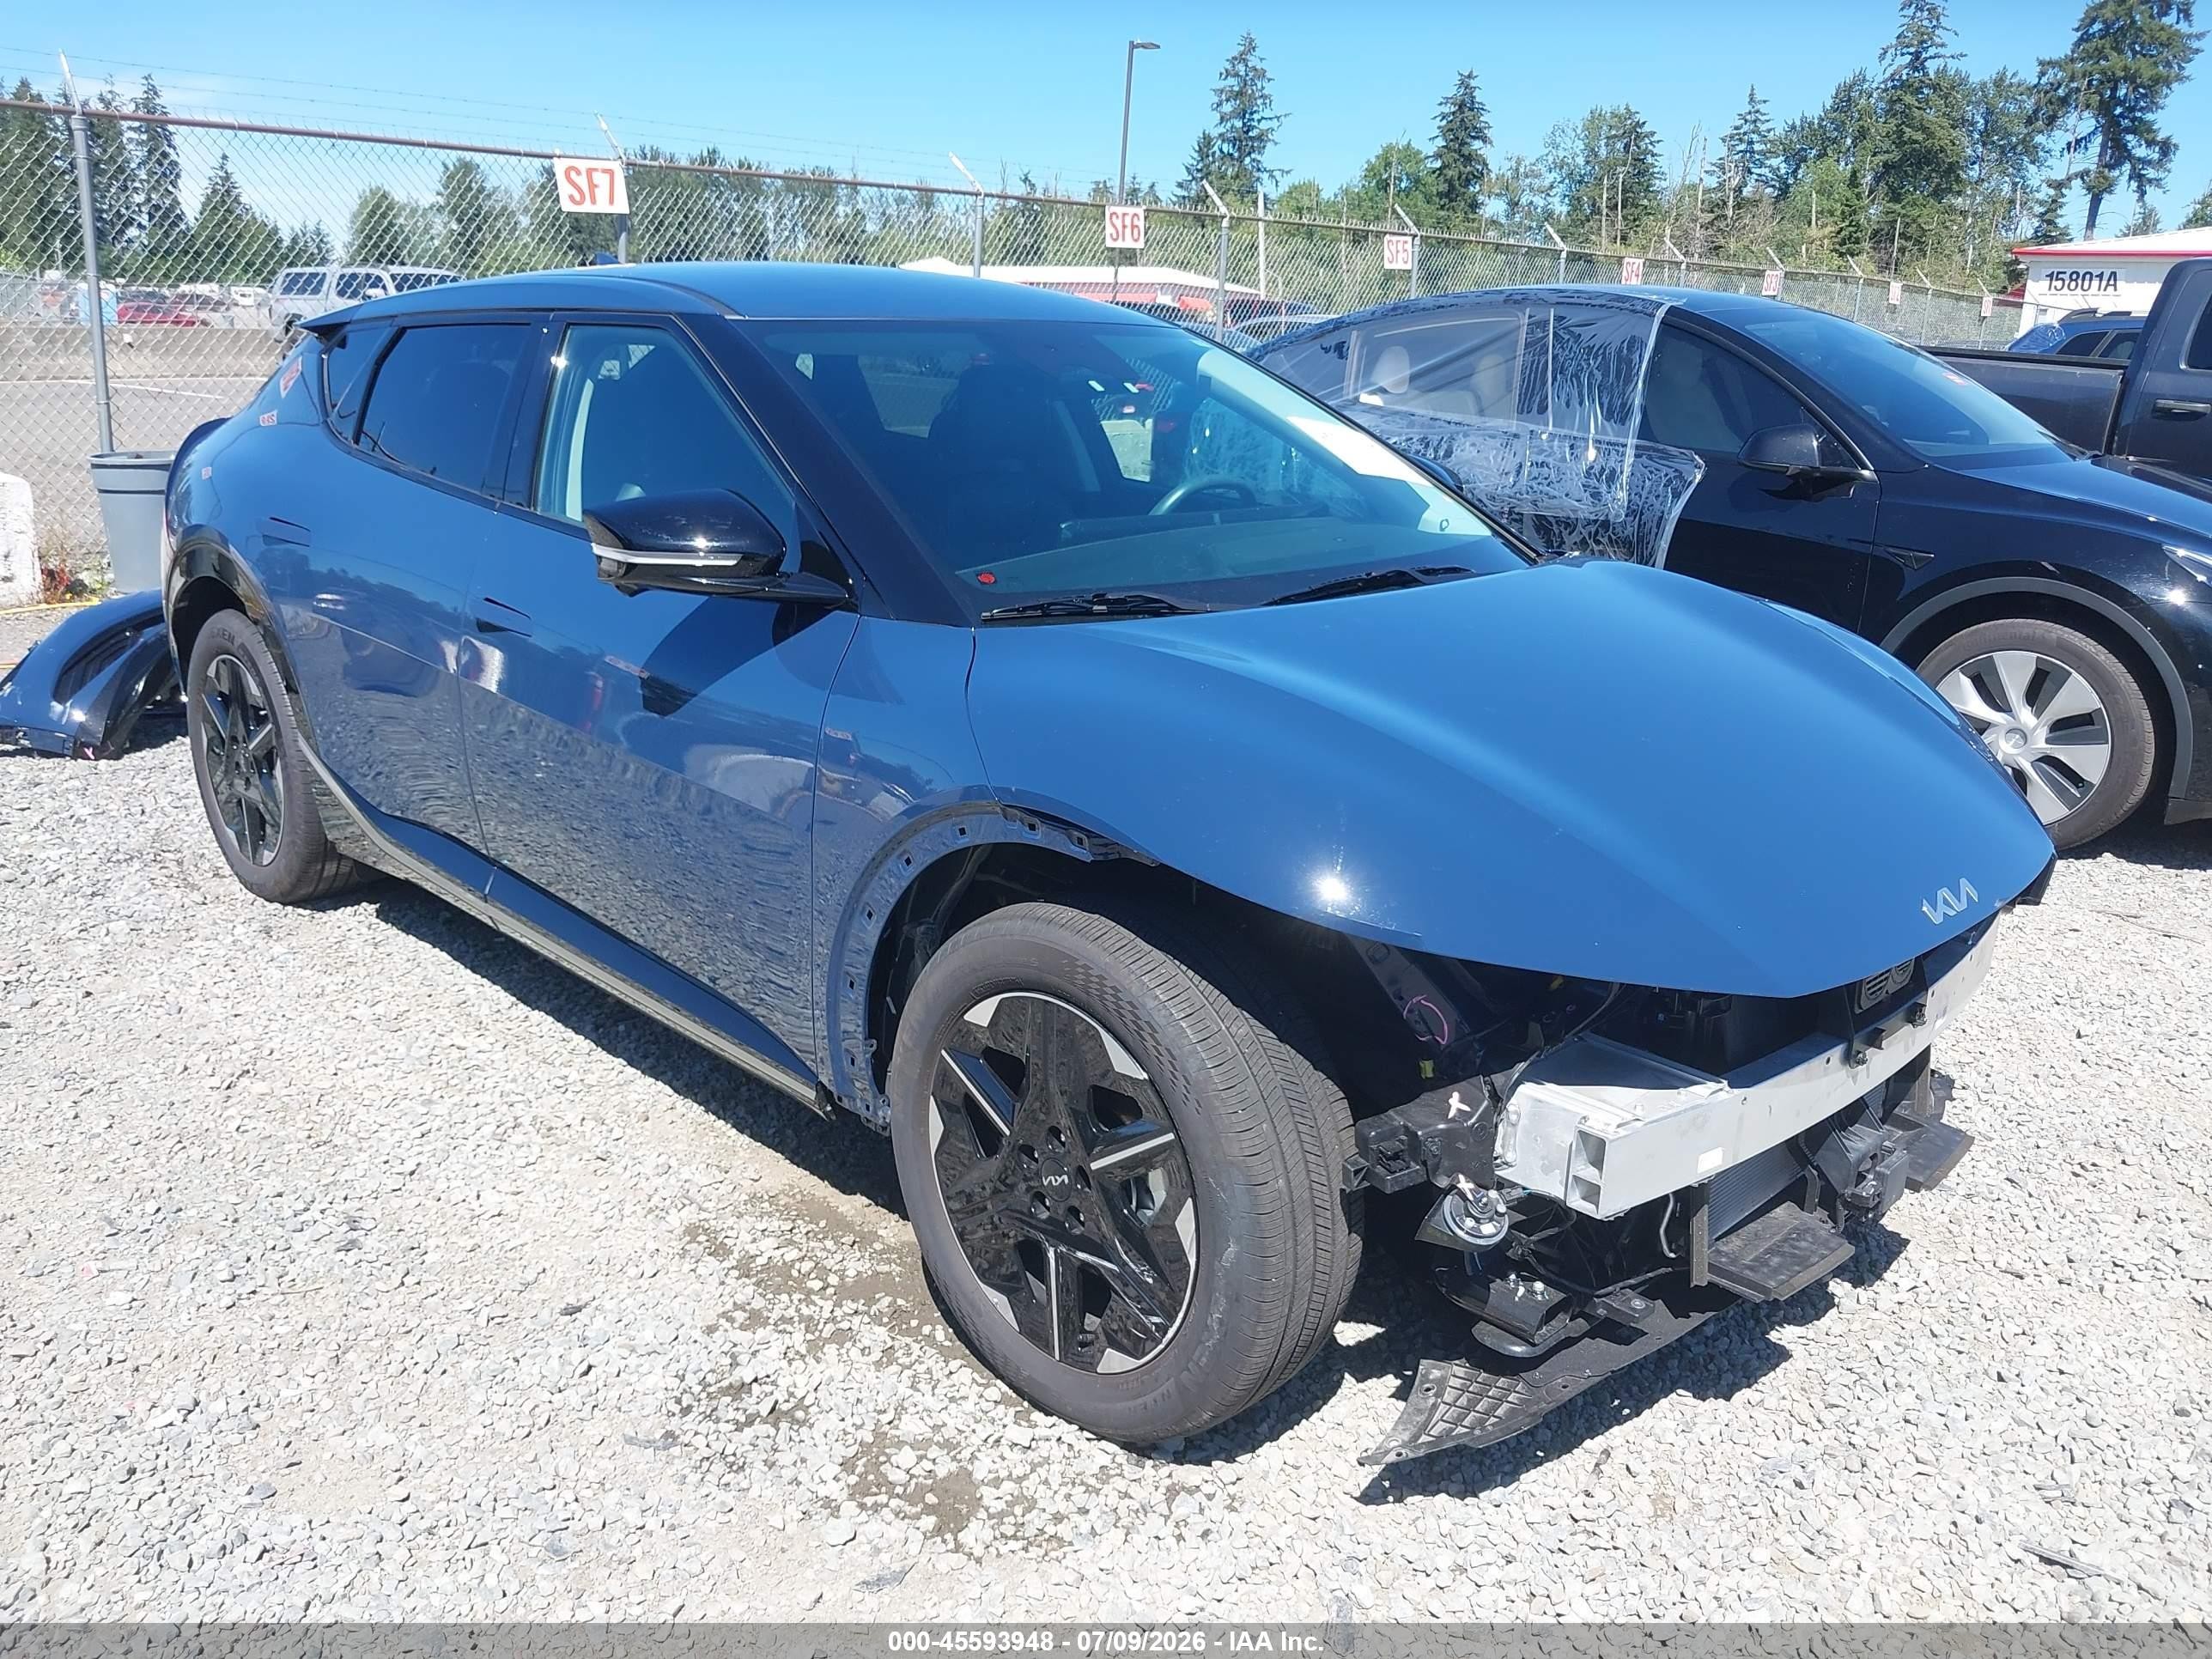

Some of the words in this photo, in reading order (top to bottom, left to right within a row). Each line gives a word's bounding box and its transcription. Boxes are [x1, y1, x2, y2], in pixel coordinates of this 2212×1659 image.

[564, 166, 615, 206] SF7
[1109, 211, 1141, 242] SF6
[1387, 240, 1409, 264] SF5
[1624, 261, 1641, 283] SF4
[1764, 273, 1779, 292] SF3
[2045, 270, 2118, 292] 15801A
[1922, 877, 1979, 925] KIA
